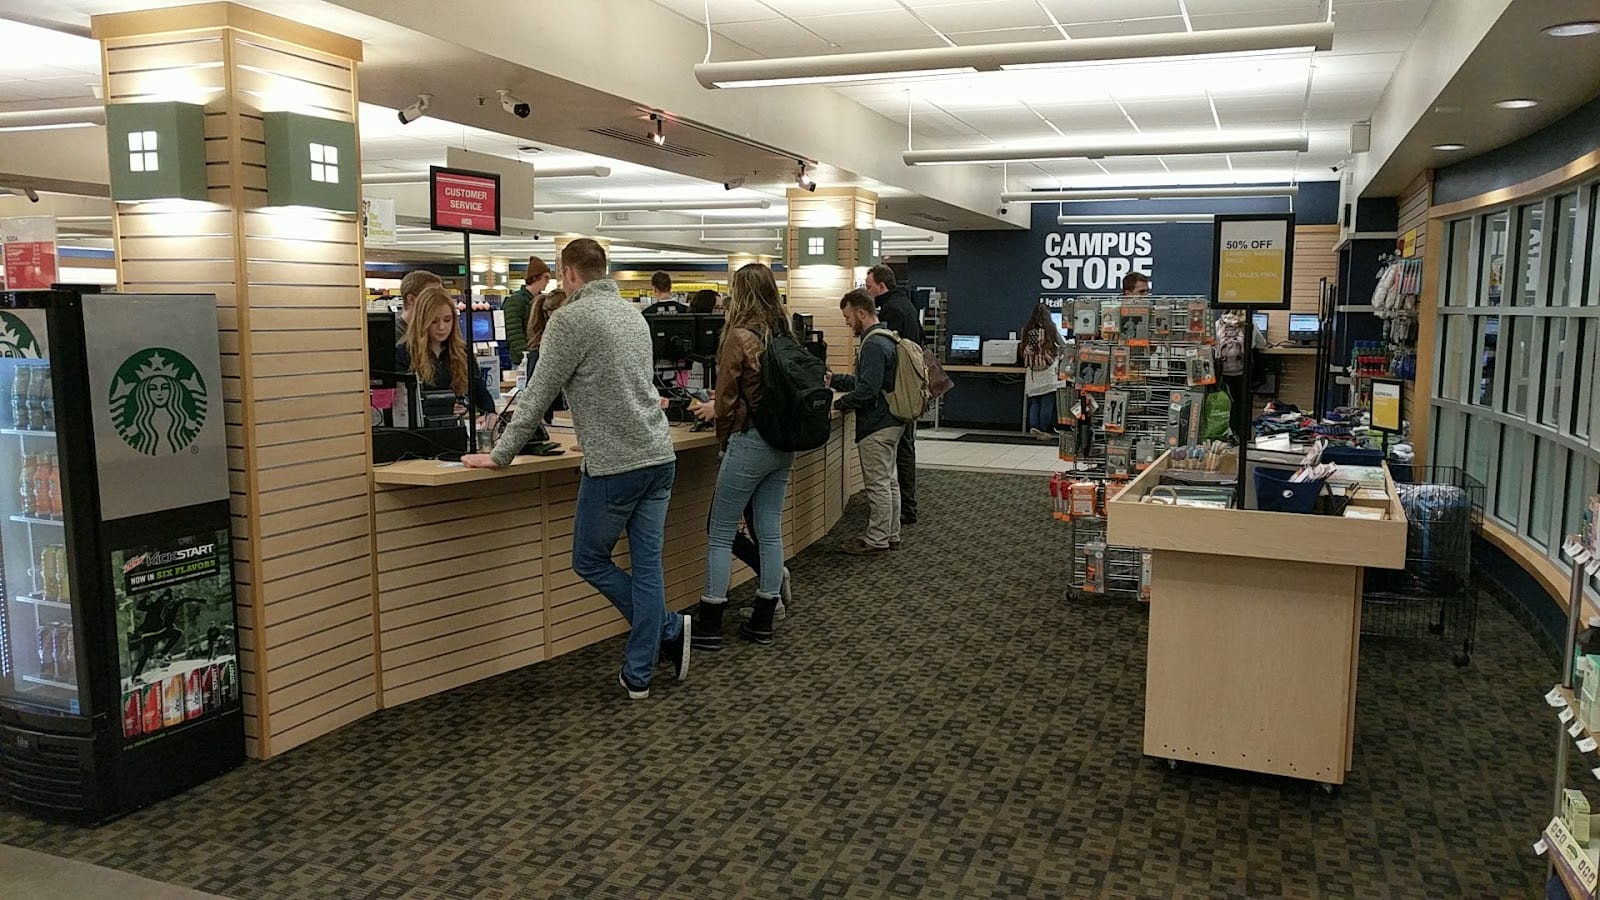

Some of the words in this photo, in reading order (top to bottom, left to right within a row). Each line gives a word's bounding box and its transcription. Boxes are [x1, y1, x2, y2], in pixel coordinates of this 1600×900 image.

[445, 187, 487, 200] CUSTOMER
[450, 200, 482, 211] SERVICE
[1045, 232, 1152, 256] CAMPUS
[1226, 240, 1248, 249] 50%
[1251, 240, 1273, 249] OFF
[1041, 257, 1153, 289] STORE
[130, 573, 146, 585] NOW
[147, 572, 155, 582] IN
[156, 568, 173, 579] SIX
[175, 559, 216, 576] FLAVORS
